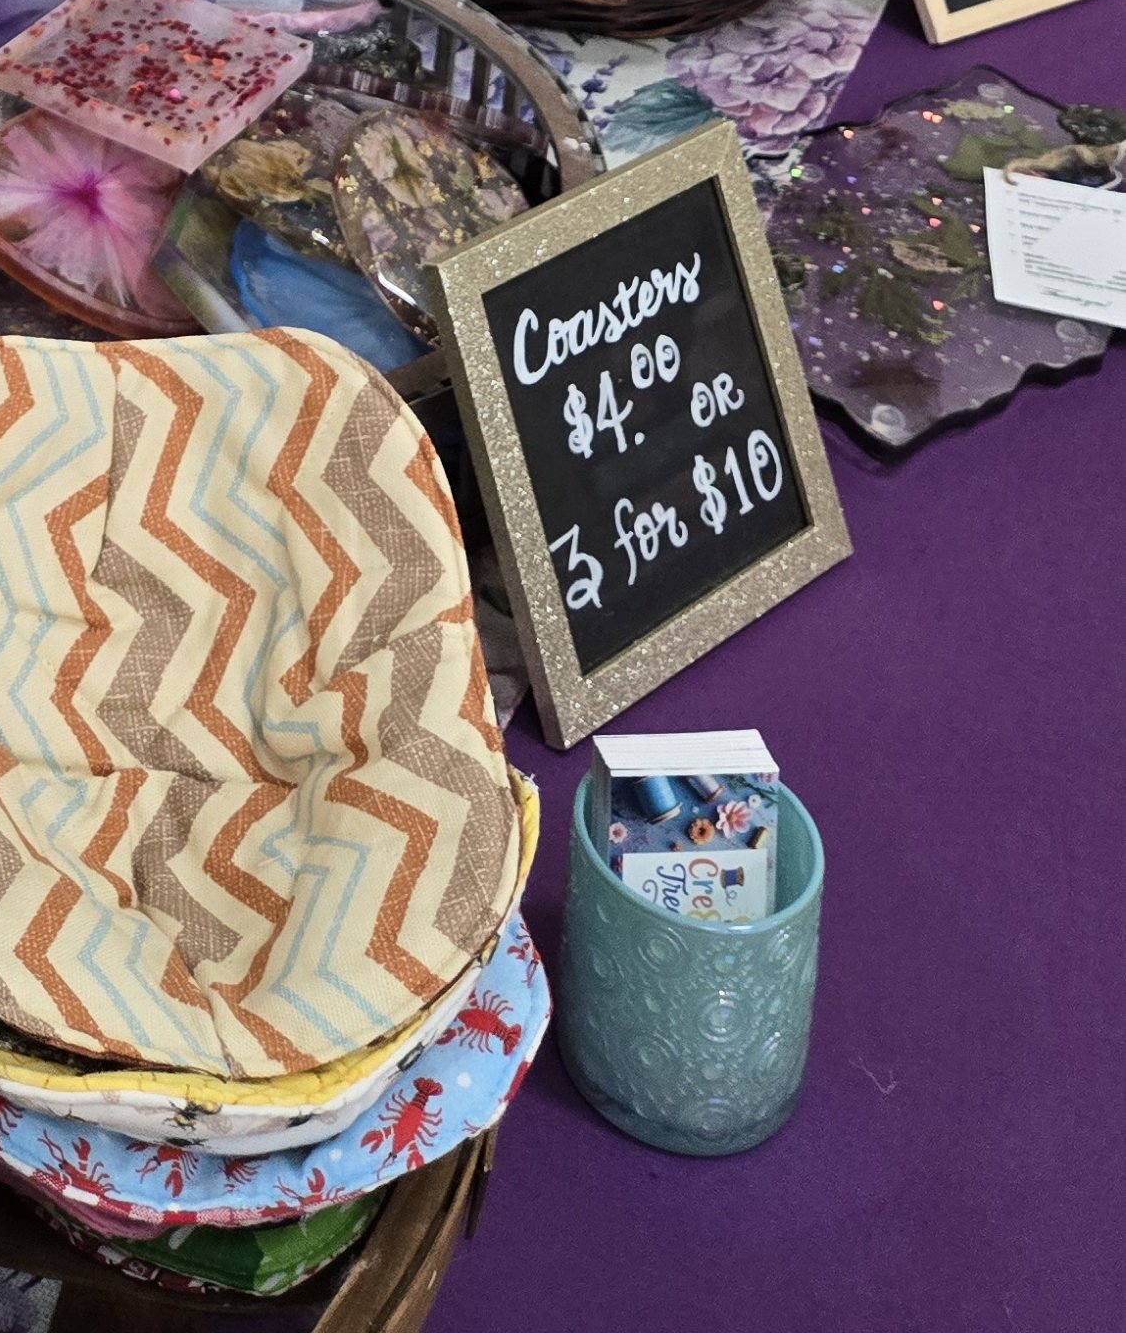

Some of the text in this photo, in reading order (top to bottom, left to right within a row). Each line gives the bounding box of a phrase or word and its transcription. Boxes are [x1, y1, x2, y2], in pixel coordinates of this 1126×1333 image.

[513, 252, 701, 385] Coasters
[690, 372, 745, 427] OR
[549, 429, 783, 609] 3 for $10
